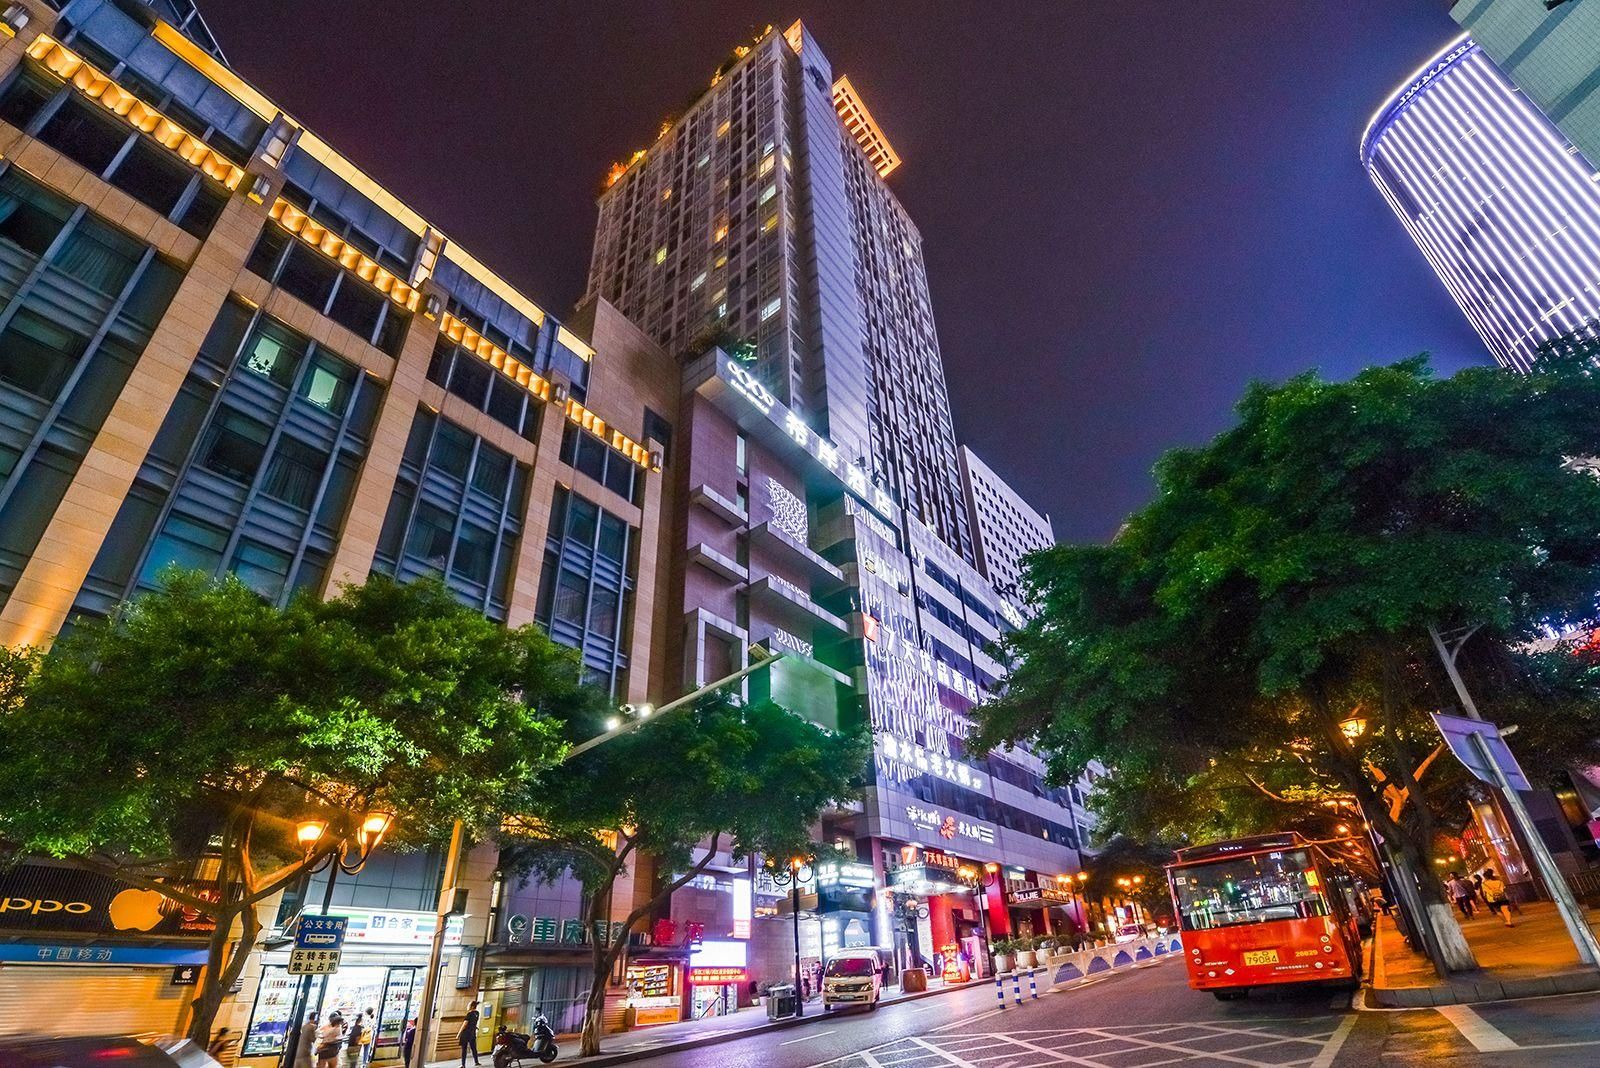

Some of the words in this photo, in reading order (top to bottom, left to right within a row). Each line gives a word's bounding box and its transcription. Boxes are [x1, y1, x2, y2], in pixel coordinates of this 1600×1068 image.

[304, 920, 343, 930] 公交专用
[37, 946, 113, 961] 中国移动
[294, 951, 339, 960] 左转车辆
[1247, 955, 1277, 965] 79084
[292, 962, 336, 971] 禁止占用
